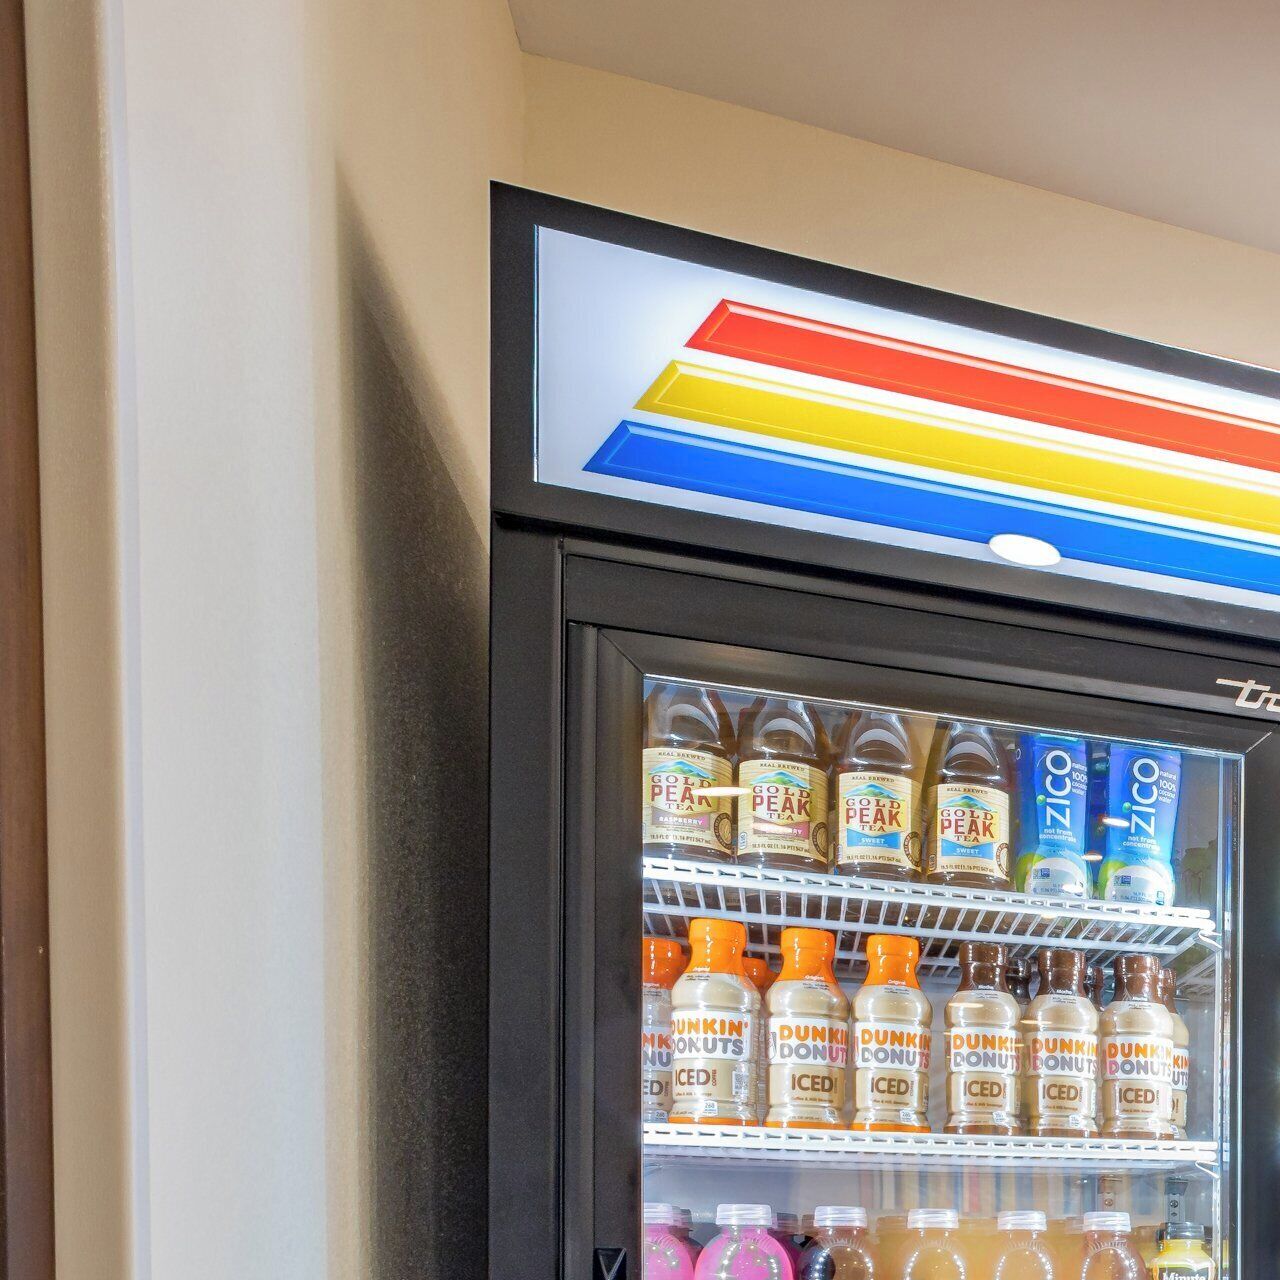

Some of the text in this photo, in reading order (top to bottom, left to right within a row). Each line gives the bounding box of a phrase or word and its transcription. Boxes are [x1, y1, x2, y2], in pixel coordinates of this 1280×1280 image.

[651, 775, 712, 788] GOLD
[1160, 771, 1177, 780] natural
[753, 785, 810, 798] GOLD
[1038, 750, 1072, 828] ZICO
[1159, 780, 1177, 791] 100%
[651, 785, 712, 807] PEAK
[846, 798, 901, 809] GOLD
[1123, 758, 1159, 836] ZICO
[665, 803, 694, 811] TEA
[753, 794, 811, 817] PEAK
[658, 816, 702, 825] RASPBERRY
[767, 812, 794, 821] TEA
[845, 808, 902, 827] PEAK
[941, 809, 994, 820] GOLD
[941, 819, 995, 838] PEAK
[1141, 836, 1156, 844] from
[861, 1050, 930, 1071] DONUTS
[1032, 1055, 1097, 1073] DONUTS
[1108, 1060, 1171, 1077] DONUTS
[675, 1068, 710, 1087] ICED
[792, 1073, 833, 1093] ICED
[871, 1076, 909, 1095] ICED
[963, 1080, 1002, 1097] ICED
[1042, 1083, 1079, 1101] ICED
[1119, 1087, 1155, 1104] ICED
